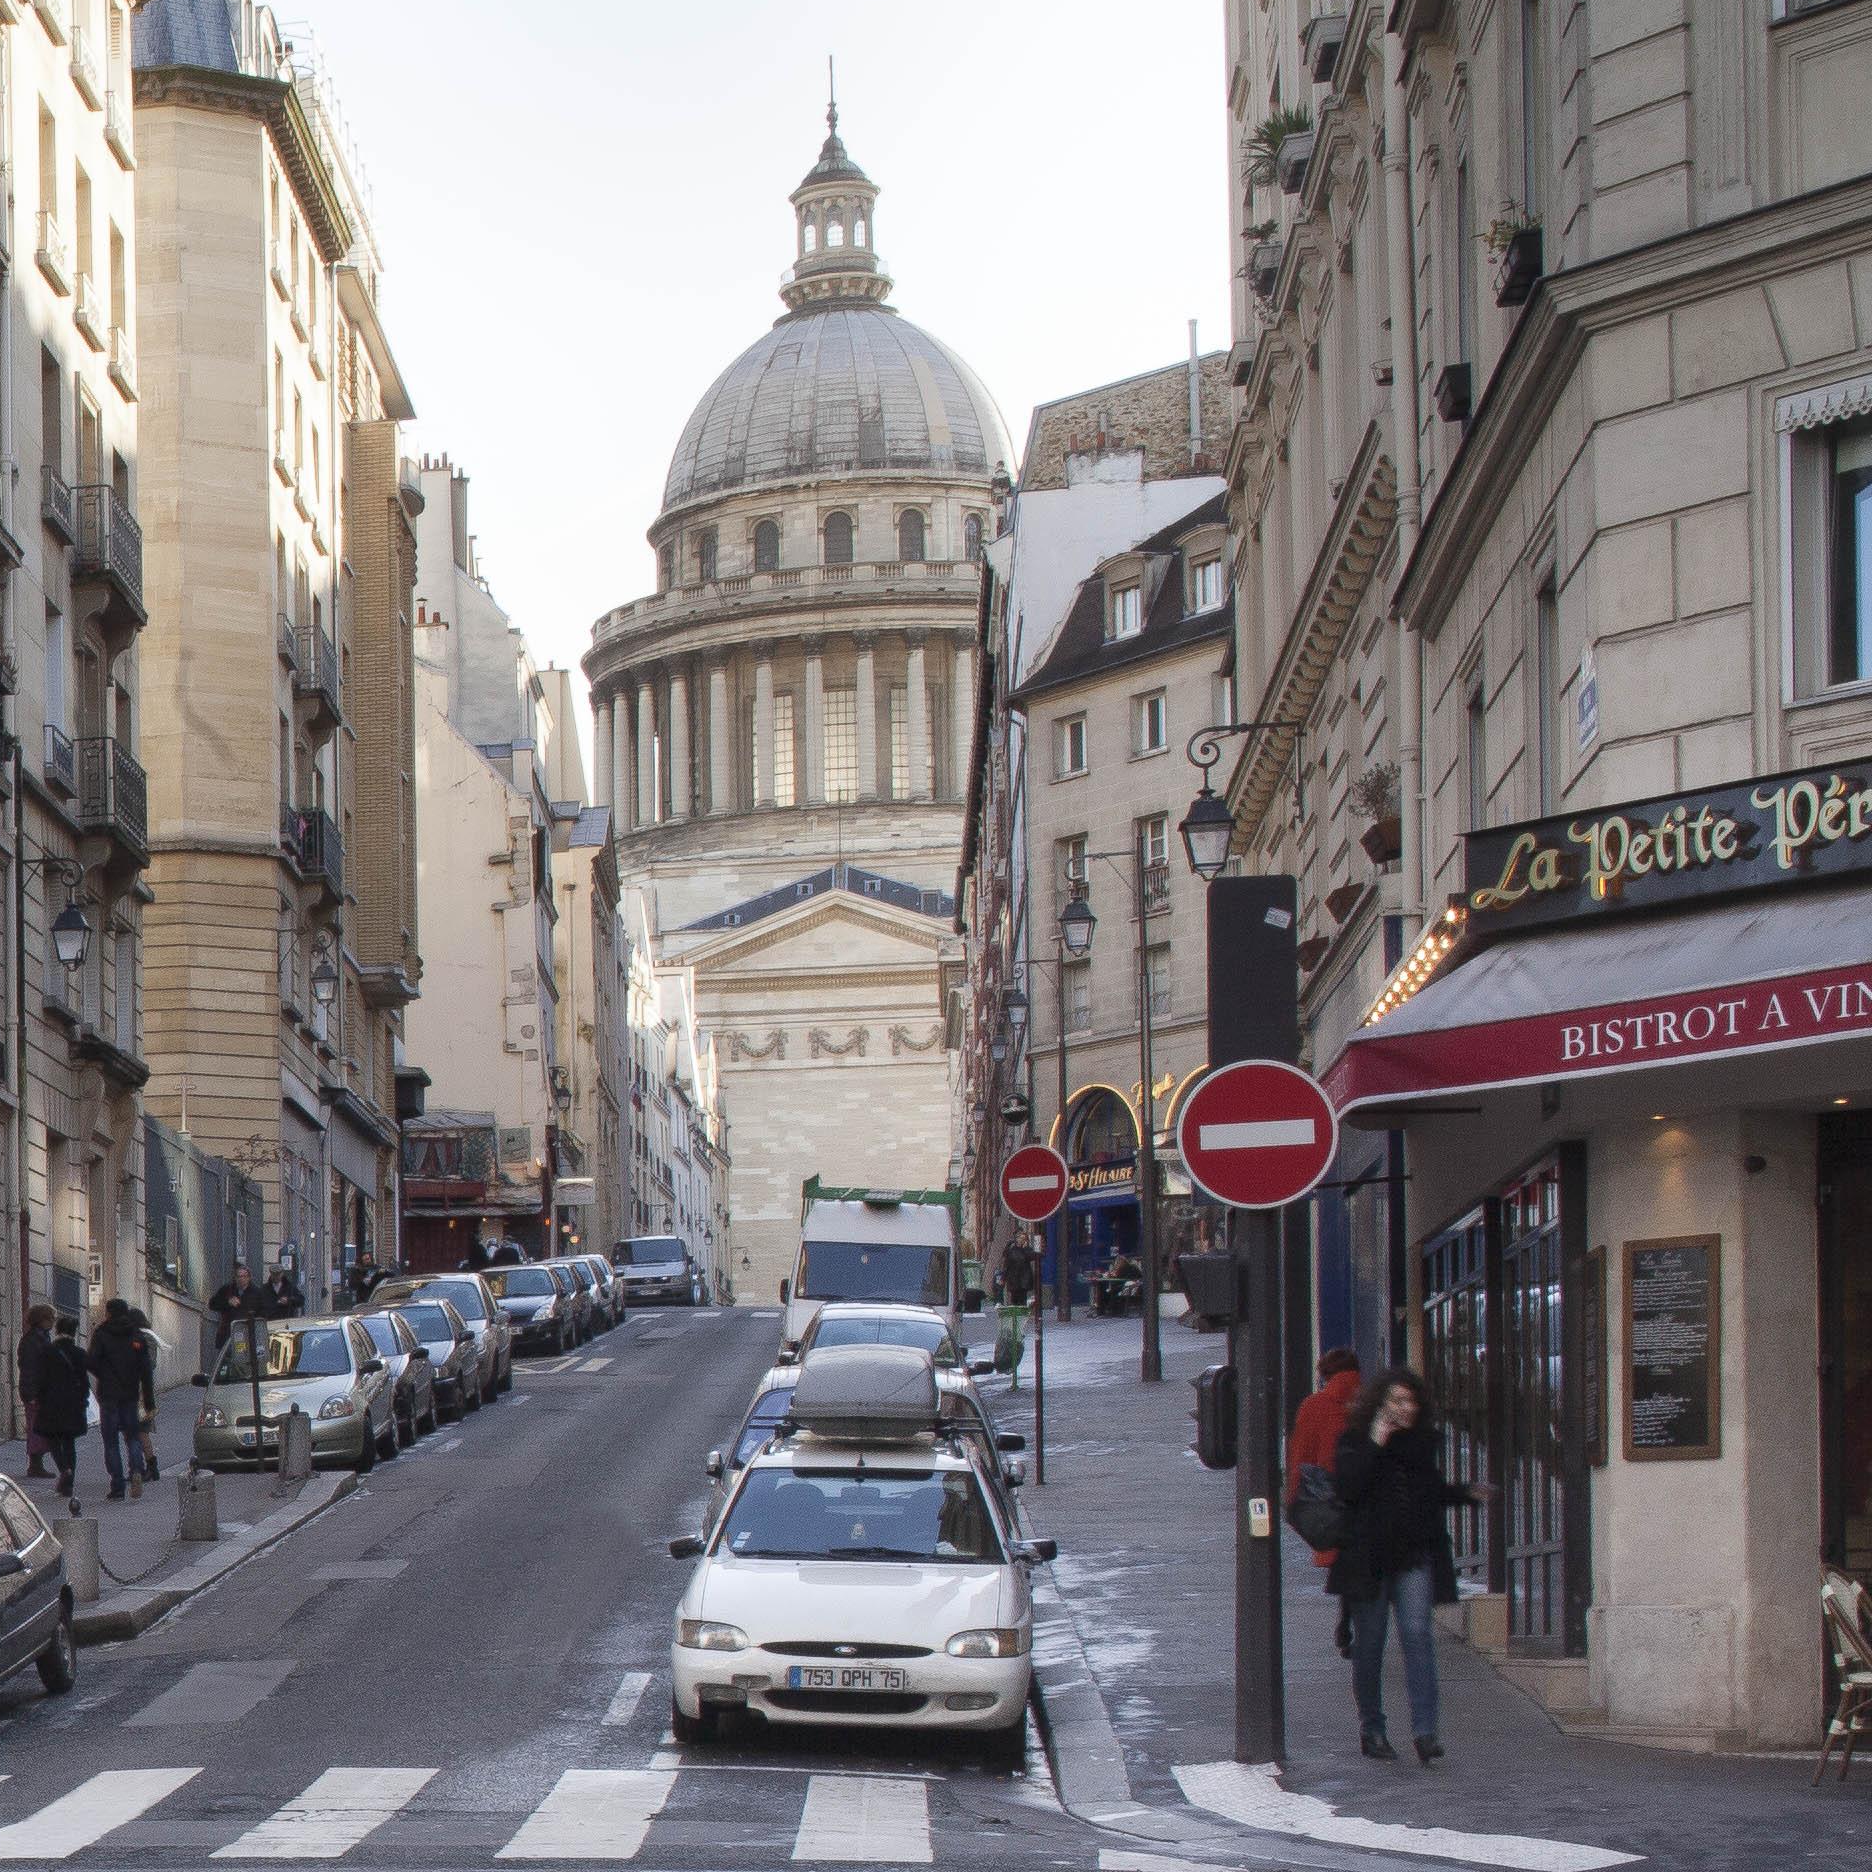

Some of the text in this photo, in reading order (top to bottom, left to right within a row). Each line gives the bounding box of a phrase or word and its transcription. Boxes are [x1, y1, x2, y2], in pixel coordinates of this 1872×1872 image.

[1470, 832, 1562, 910] La
[1568, 804, 1739, 901] Petite
[1561, 999, 1748, 1060] BISTROT
[1758, 993, 1789, 1030] A
[804, 1669, 901, 1688] 753 QPH 75
